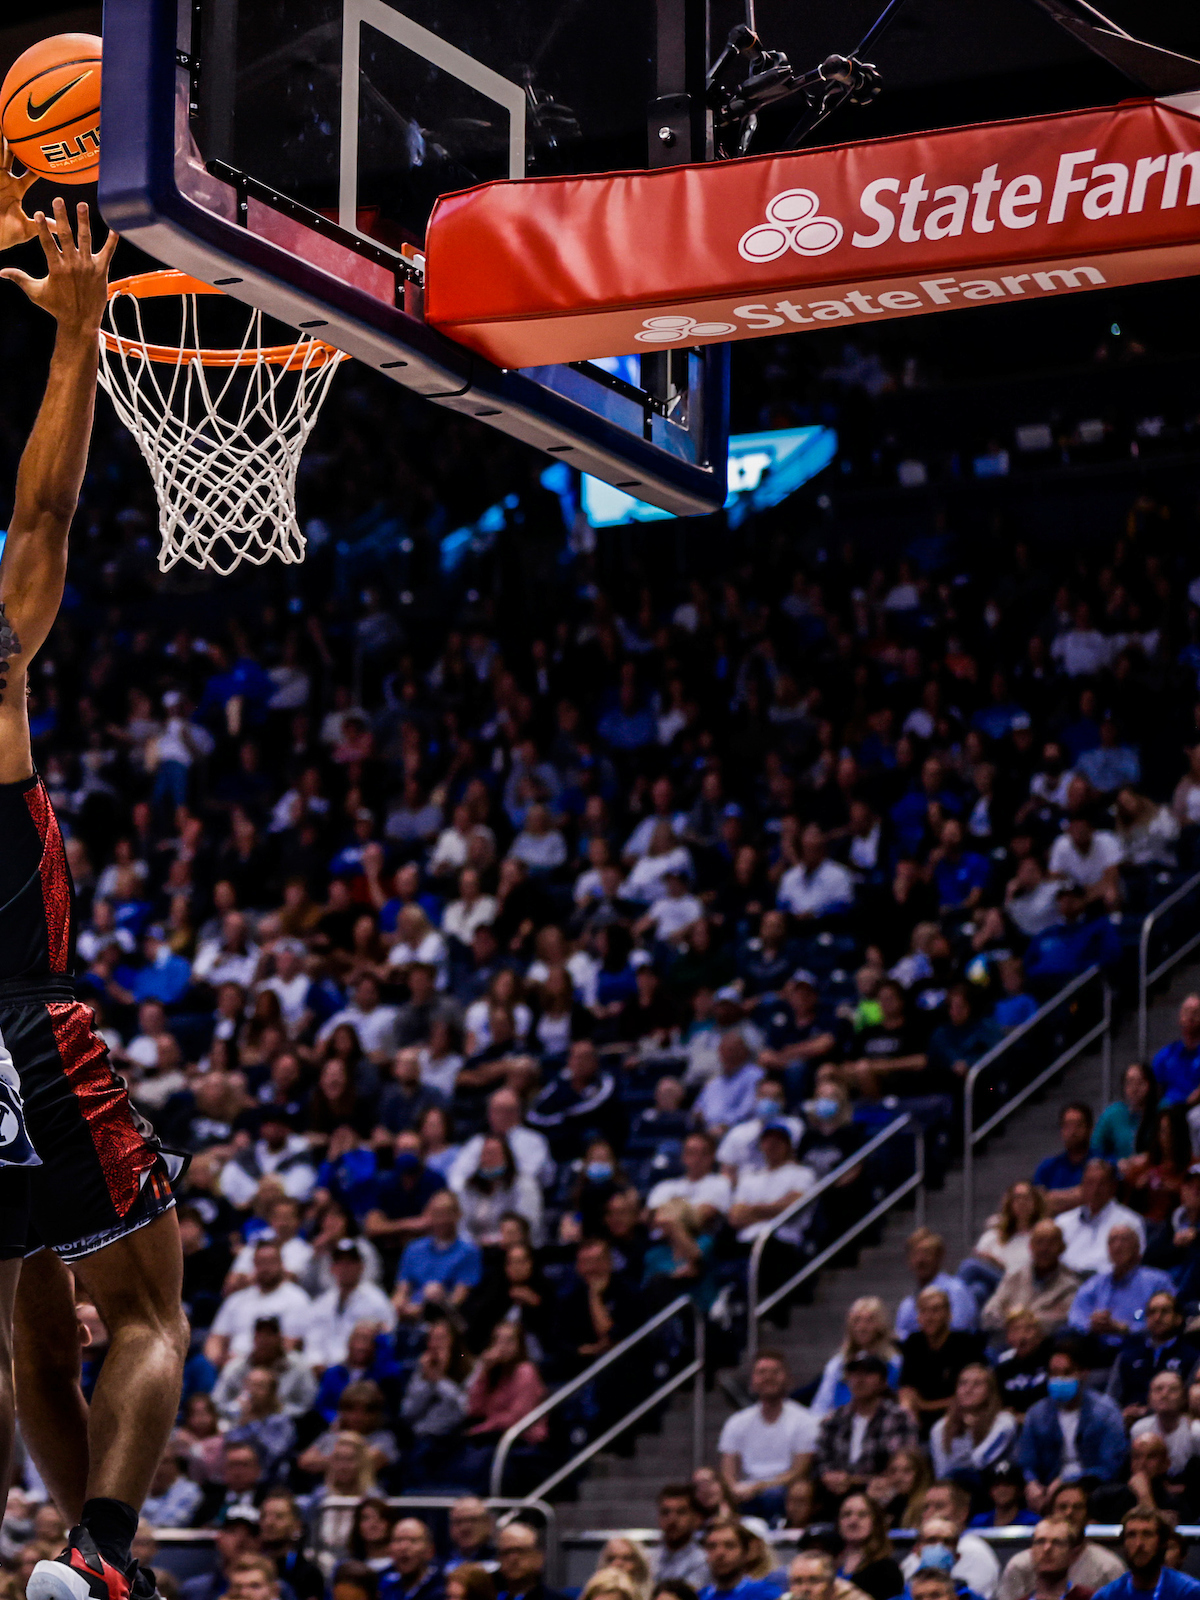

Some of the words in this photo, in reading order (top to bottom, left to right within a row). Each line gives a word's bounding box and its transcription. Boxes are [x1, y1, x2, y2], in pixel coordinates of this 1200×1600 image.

[40, 126, 100, 163] ELIT
[851, 163, 1044, 249] State
[733, 289, 923, 329] State
[919, 266, 1107, 304] Farm
